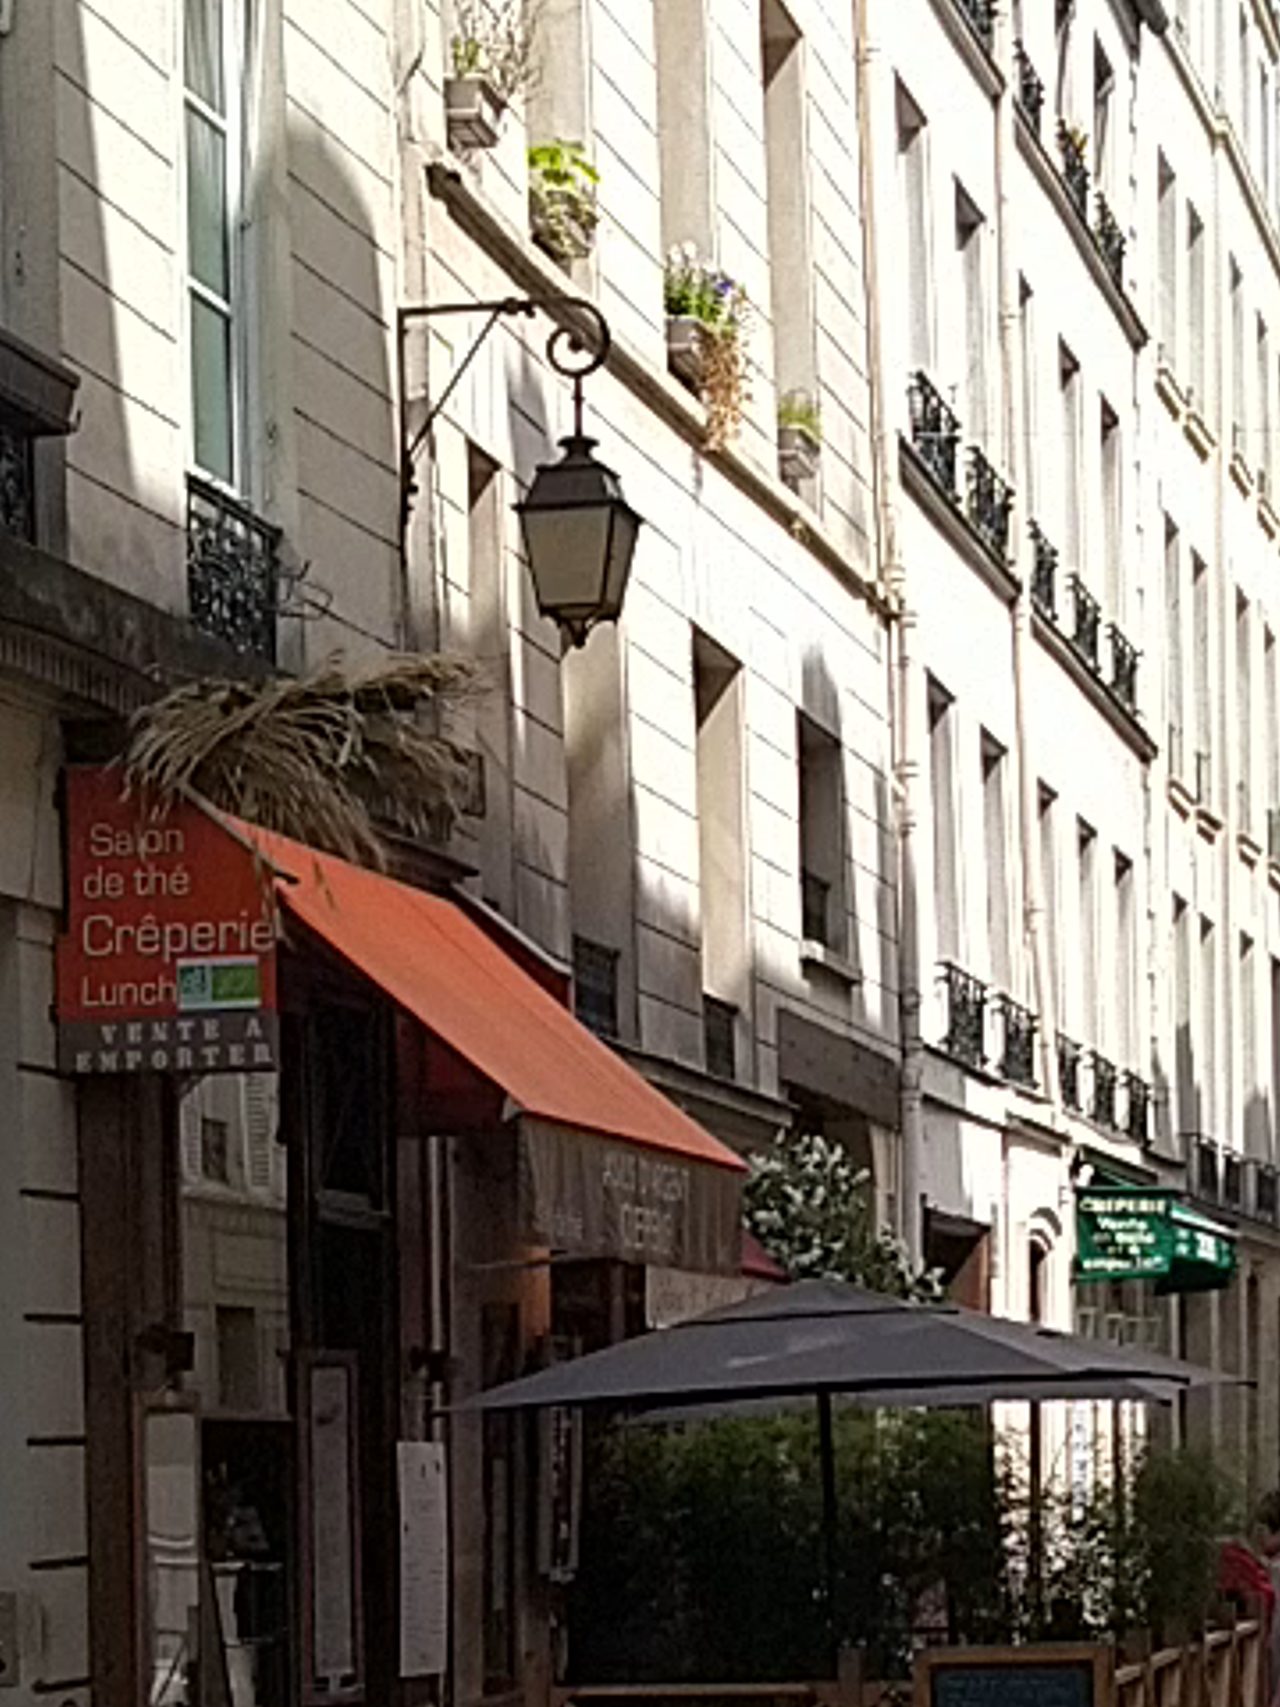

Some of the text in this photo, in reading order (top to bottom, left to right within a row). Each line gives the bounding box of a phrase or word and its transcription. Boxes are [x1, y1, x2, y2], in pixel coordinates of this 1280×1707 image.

[90, 823, 184, 857] Salon
[83, 865, 190, 898] de thé
[83, 911, 275, 964] Crêperie
[82, 974, 177, 1007] Lunch
[101, 1018, 263, 1043] VENTE A
[76, 1044, 272, 1073] EMPORTER
